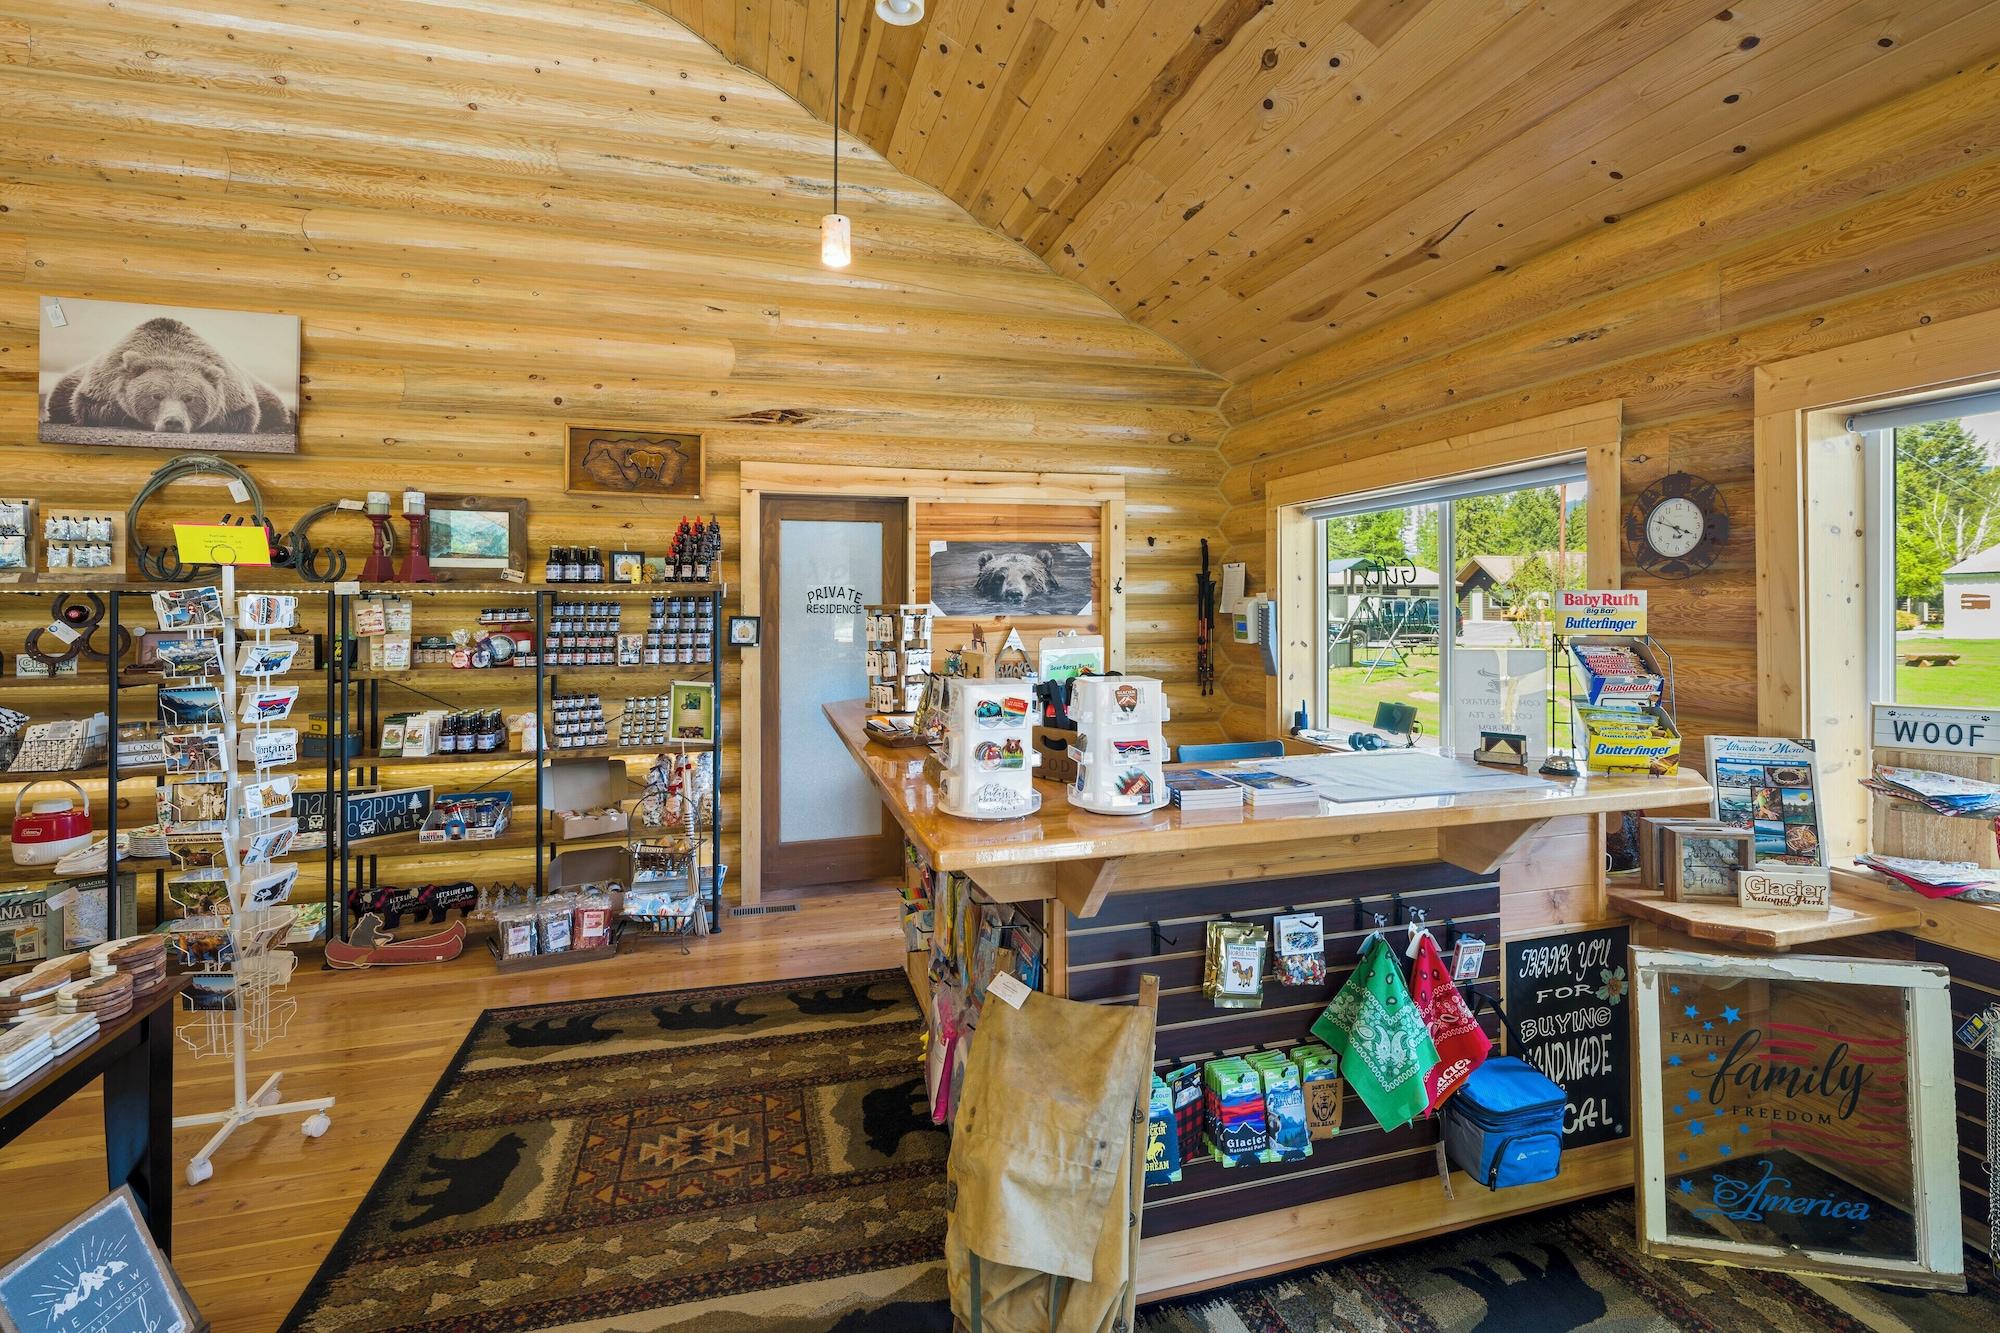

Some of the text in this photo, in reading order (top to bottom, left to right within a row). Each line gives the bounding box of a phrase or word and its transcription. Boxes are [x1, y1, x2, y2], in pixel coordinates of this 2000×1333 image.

[807, 585, 863, 604] PRIVATE
[1563, 593, 1640, 608] Baby Ruth
[806, 604, 862, 614] RESIDENCE
[1586, 607, 1599, 615] Big
[1565, 616, 1638, 632] Butterfinger
[1892, 719, 1986, 747] WOOF
[127, 743, 160, 752] LONG
[1594, 743, 1672, 757] Butterfinger
[1769, 742, 1806, 754] Menu
[347, 794, 408, 823] happy
[78, 880, 106, 888] GLACIER
[1744, 875, 1827, 898] Glacier
[1745, 893, 1825, 907] National Park
[1519, 937, 1612, 982] THANK YOU
[1536, 983, 1595, 1004] FOR
[1520, 1006, 1612, 1044] BUYING
[1671, 1031, 1727, 1047] FAITH
[1691, 1029, 1874, 1121] family
[1562, 1097, 1614, 1135] CAL
[1732, 1105, 1831, 1125] FREEDOM
[1226, 1134, 1267, 1149] Glacier
[1229, 1146, 1254, 1154] National
[1694, 1160, 1871, 1222] America
[94, 1268, 140, 1308] VIEW
[115, 1282, 150, 1311] WORTH
